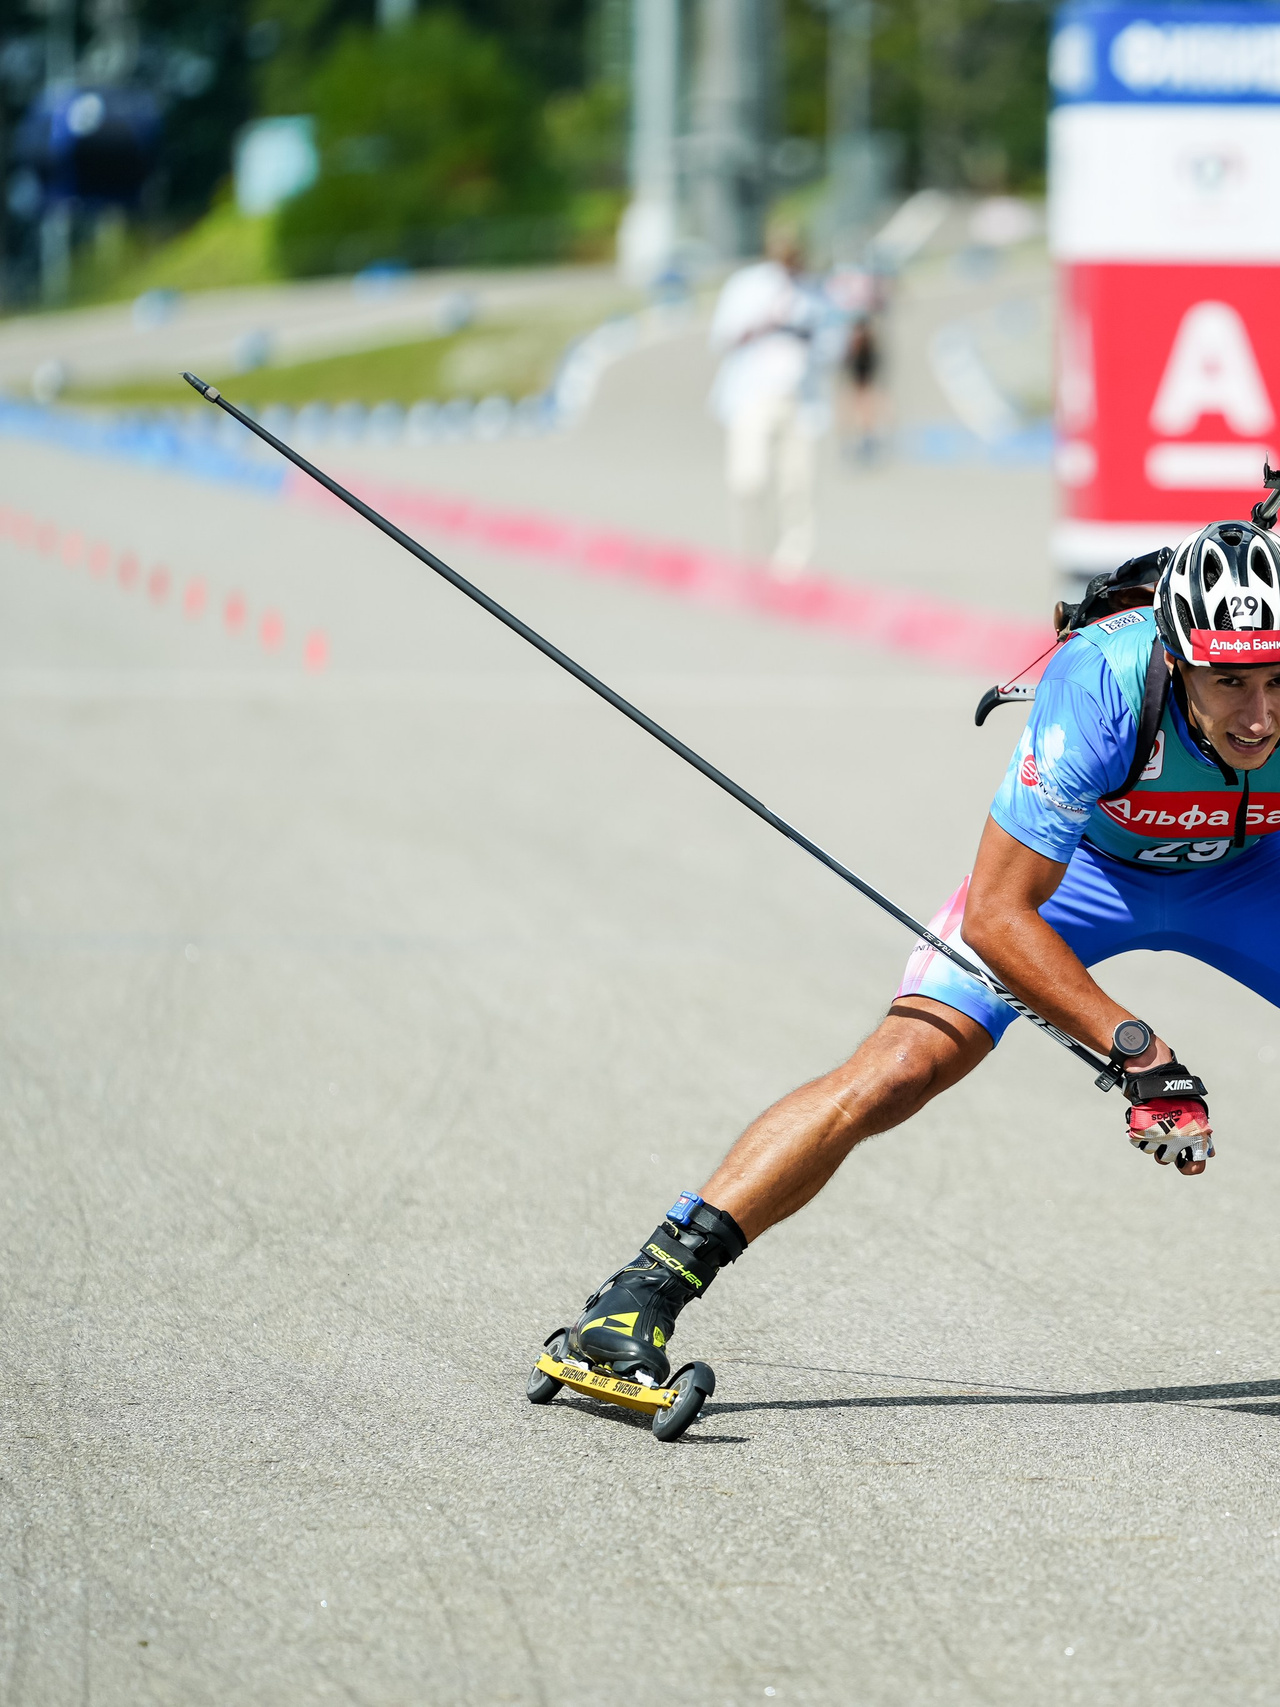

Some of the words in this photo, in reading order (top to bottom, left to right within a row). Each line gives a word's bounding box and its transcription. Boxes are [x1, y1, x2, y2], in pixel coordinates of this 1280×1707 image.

[1230, 595, 1259, 617] 29
[1209, 638, 1251, 653] Альфа
[1106, 798, 1229, 830] Альфа
[1151, 1109, 1183, 1121] adidas
[646, 1243, 703, 1289] FISCHER
[559, 1366, 588, 1383] SWENOR
[612, 1381, 642, 1398] SWENOR
